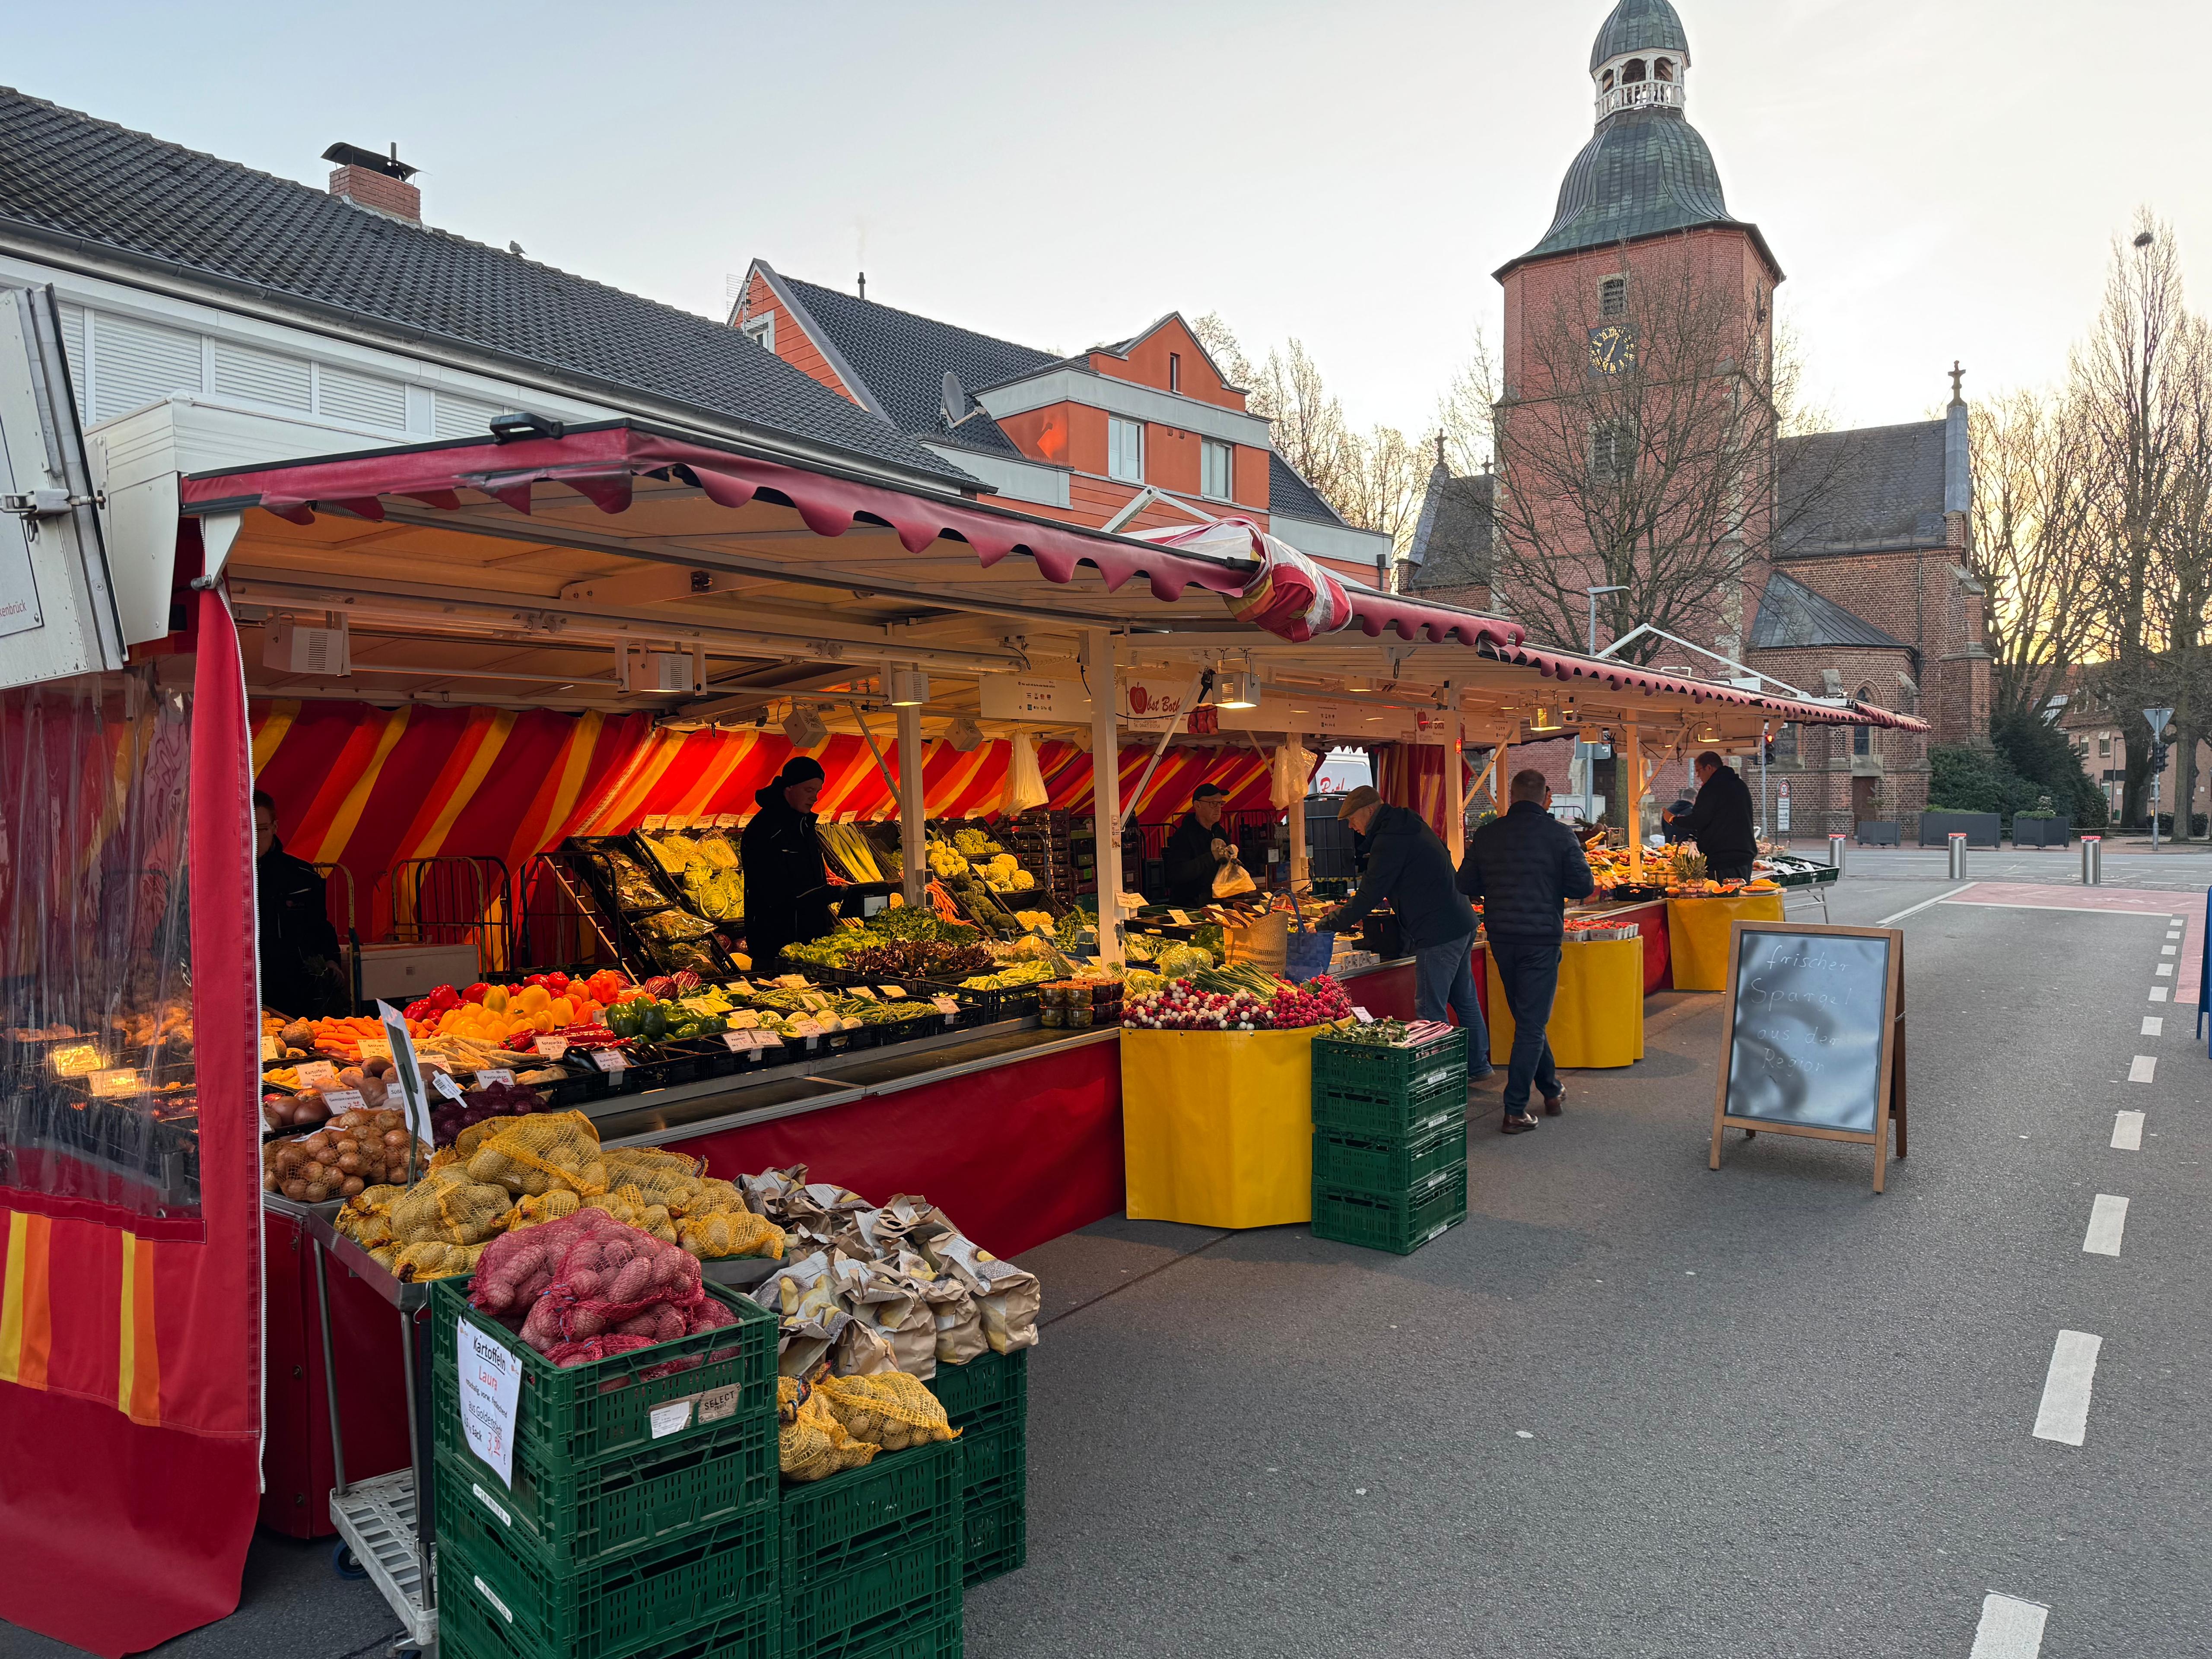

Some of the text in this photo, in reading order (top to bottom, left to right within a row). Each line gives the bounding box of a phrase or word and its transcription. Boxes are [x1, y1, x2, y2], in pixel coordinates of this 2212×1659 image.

[1767, 944, 1853, 972] frischer
[1750, 978, 1852, 1011] Spargel
[1757, 1027, 1790, 1041] aus
[1762, 1048, 1825, 1077] Region
[474, 1335, 505, 1371] Kartoffeln
[478, 1365, 498, 1391] Laura
[704, 1390, 734, 1410] SELECT
